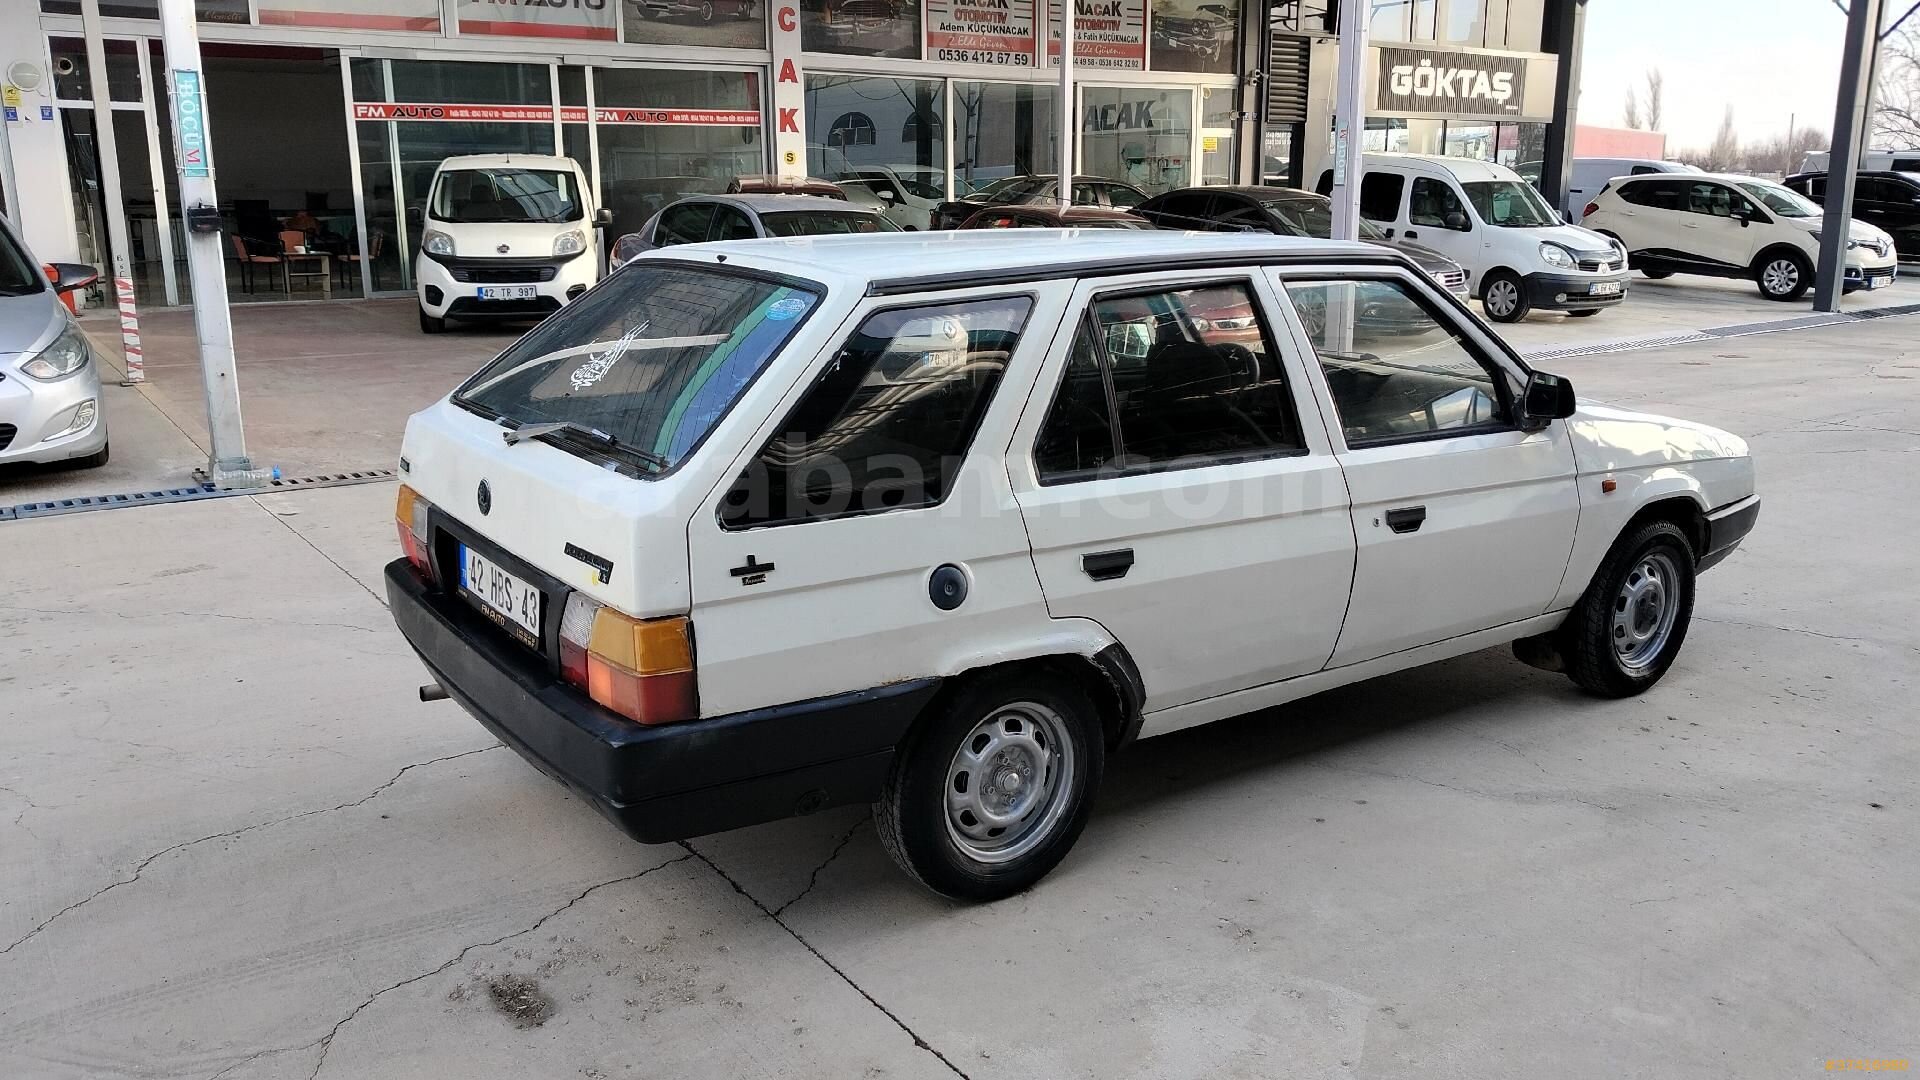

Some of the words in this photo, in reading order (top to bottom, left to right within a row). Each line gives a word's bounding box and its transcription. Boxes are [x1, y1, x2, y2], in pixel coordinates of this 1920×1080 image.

[940, 22, 964, 32] Adem
[967, 23, 1029, 36] KÜÇÜKNACAK
[938, 49, 969, 62] 0536
[971, 51, 993, 63] 412
[997, 53, 1011, 64] 67
[1014, 54, 1028, 66] 59
[1391, 59, 1514, 104] GÖKTAŞ
[356, 106, 386, 117] FM
[392, 107, 444, 118] AUTO
[595, 111, 620, 121] FM
[623, 112, 668, 122] AUTO
[484, 288, 495, 298] 42
[501, 288, 512, 297] TR
[470, 555, 484, 594] 42
[490, 566, 513, 614] HBS
[521, 587, 537, 630] 43
